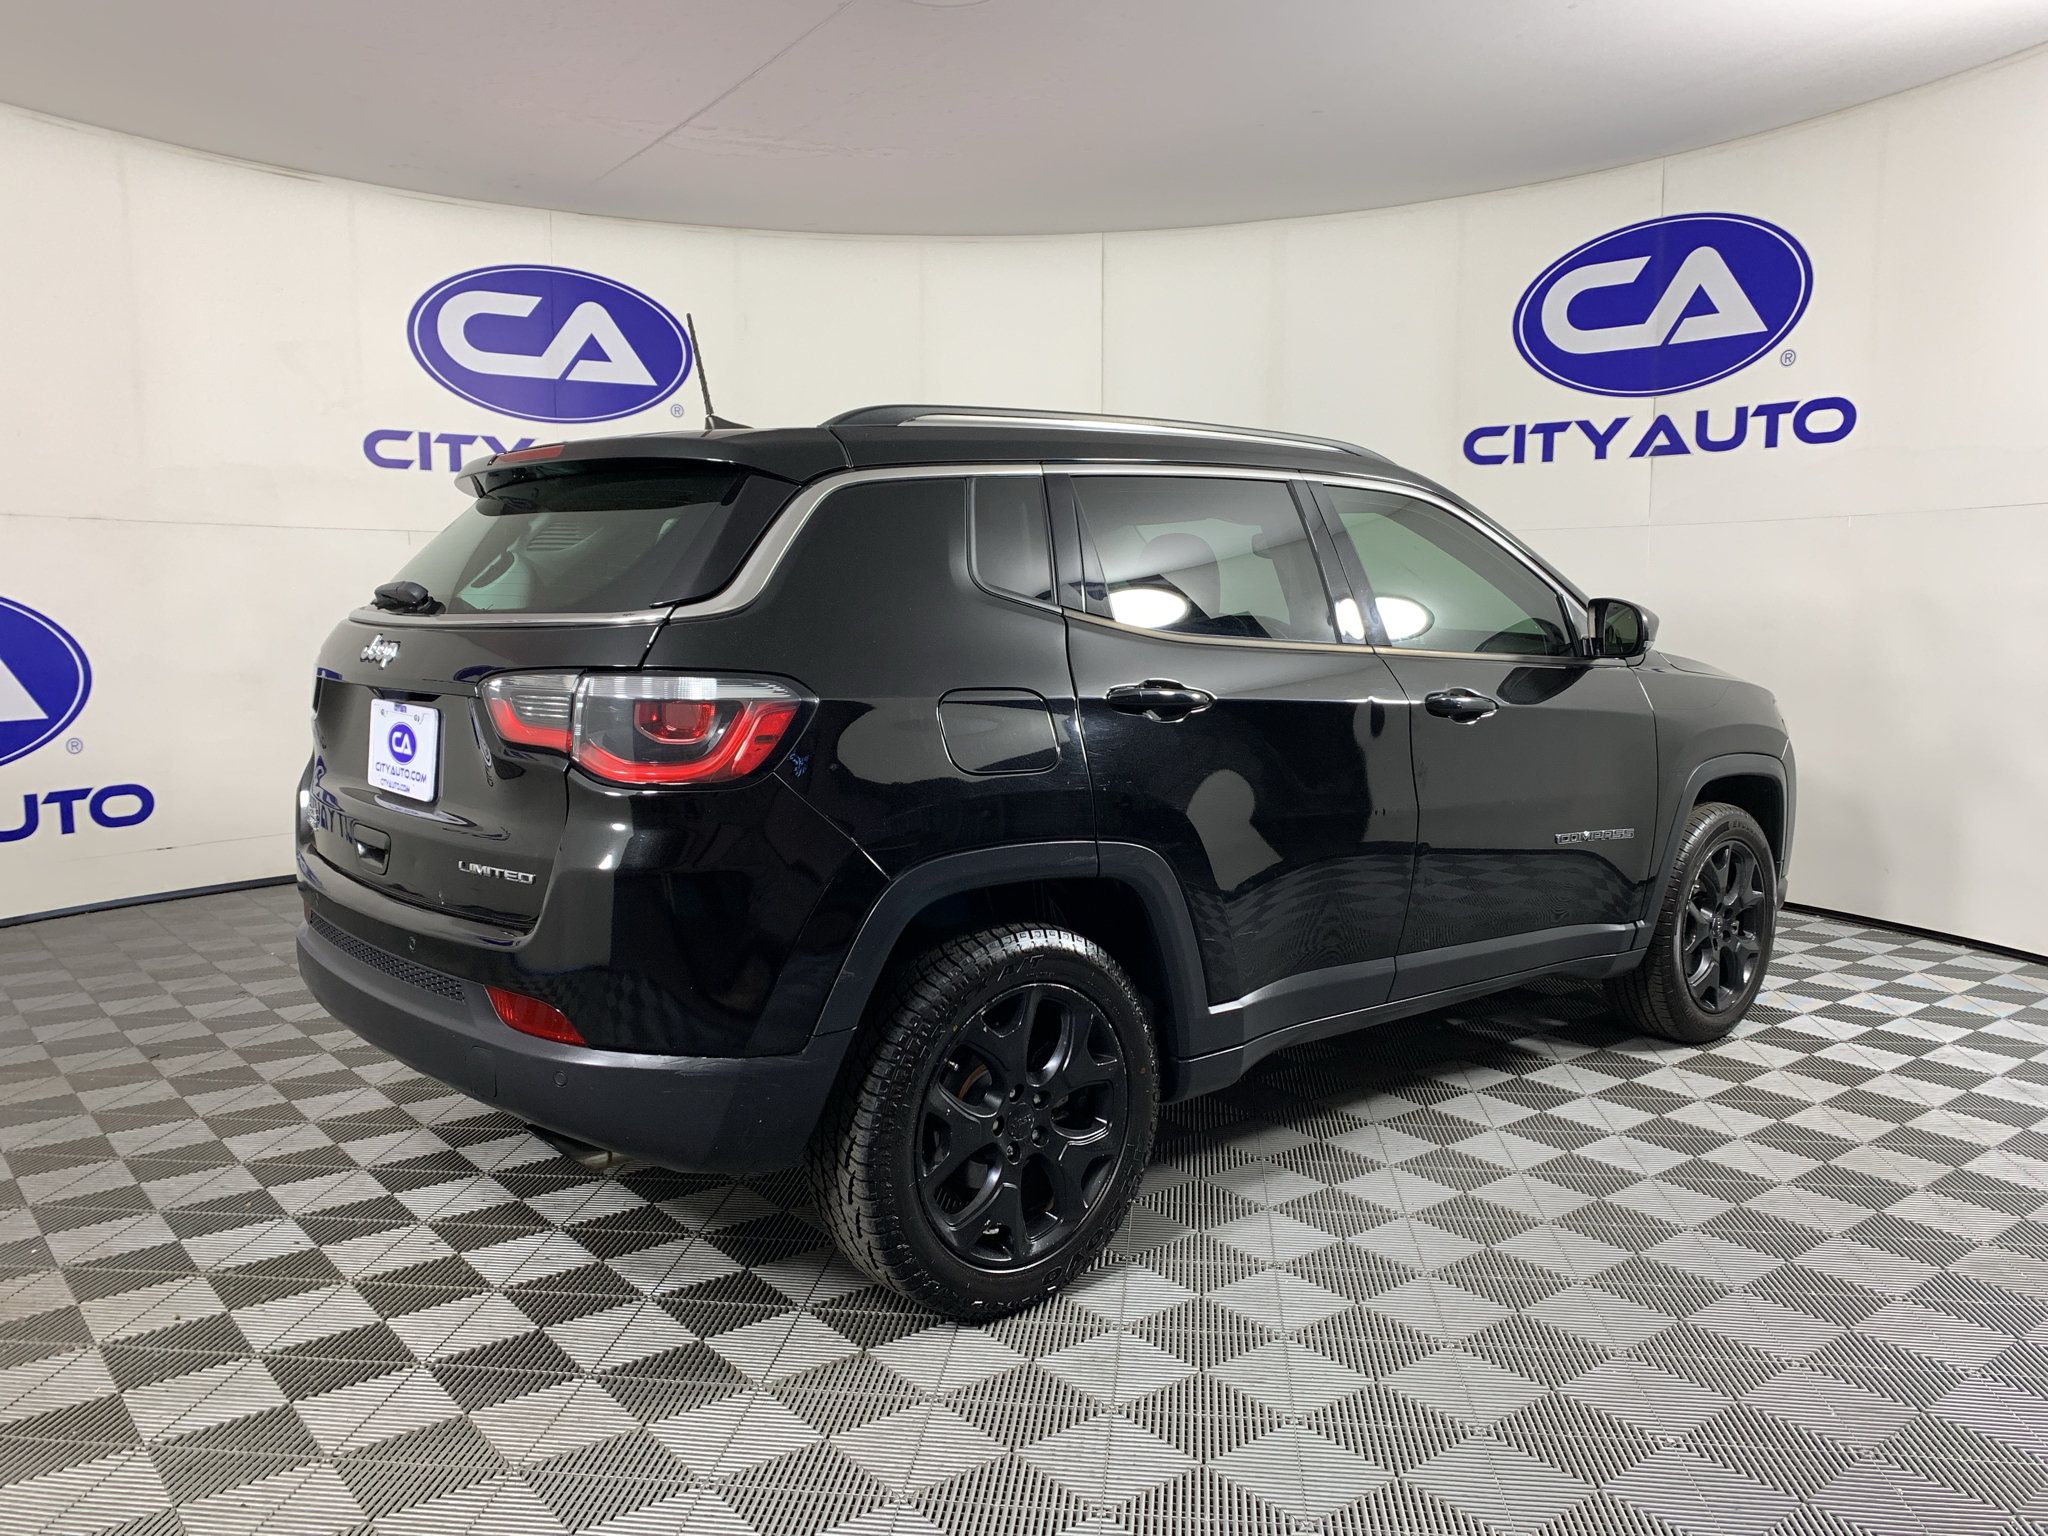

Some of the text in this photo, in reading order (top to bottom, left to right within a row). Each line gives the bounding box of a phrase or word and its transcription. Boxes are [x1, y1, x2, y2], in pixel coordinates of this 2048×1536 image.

[1541, 245, 1768, 355] CA
[437, 290, 658, 386] CA
[391, 731, 413, 756] CA
[0, 783, 155, 843] UTO
[1555, 828, 1635, 845] COMPASS
[458, 860, 537, 885] LIMITED
